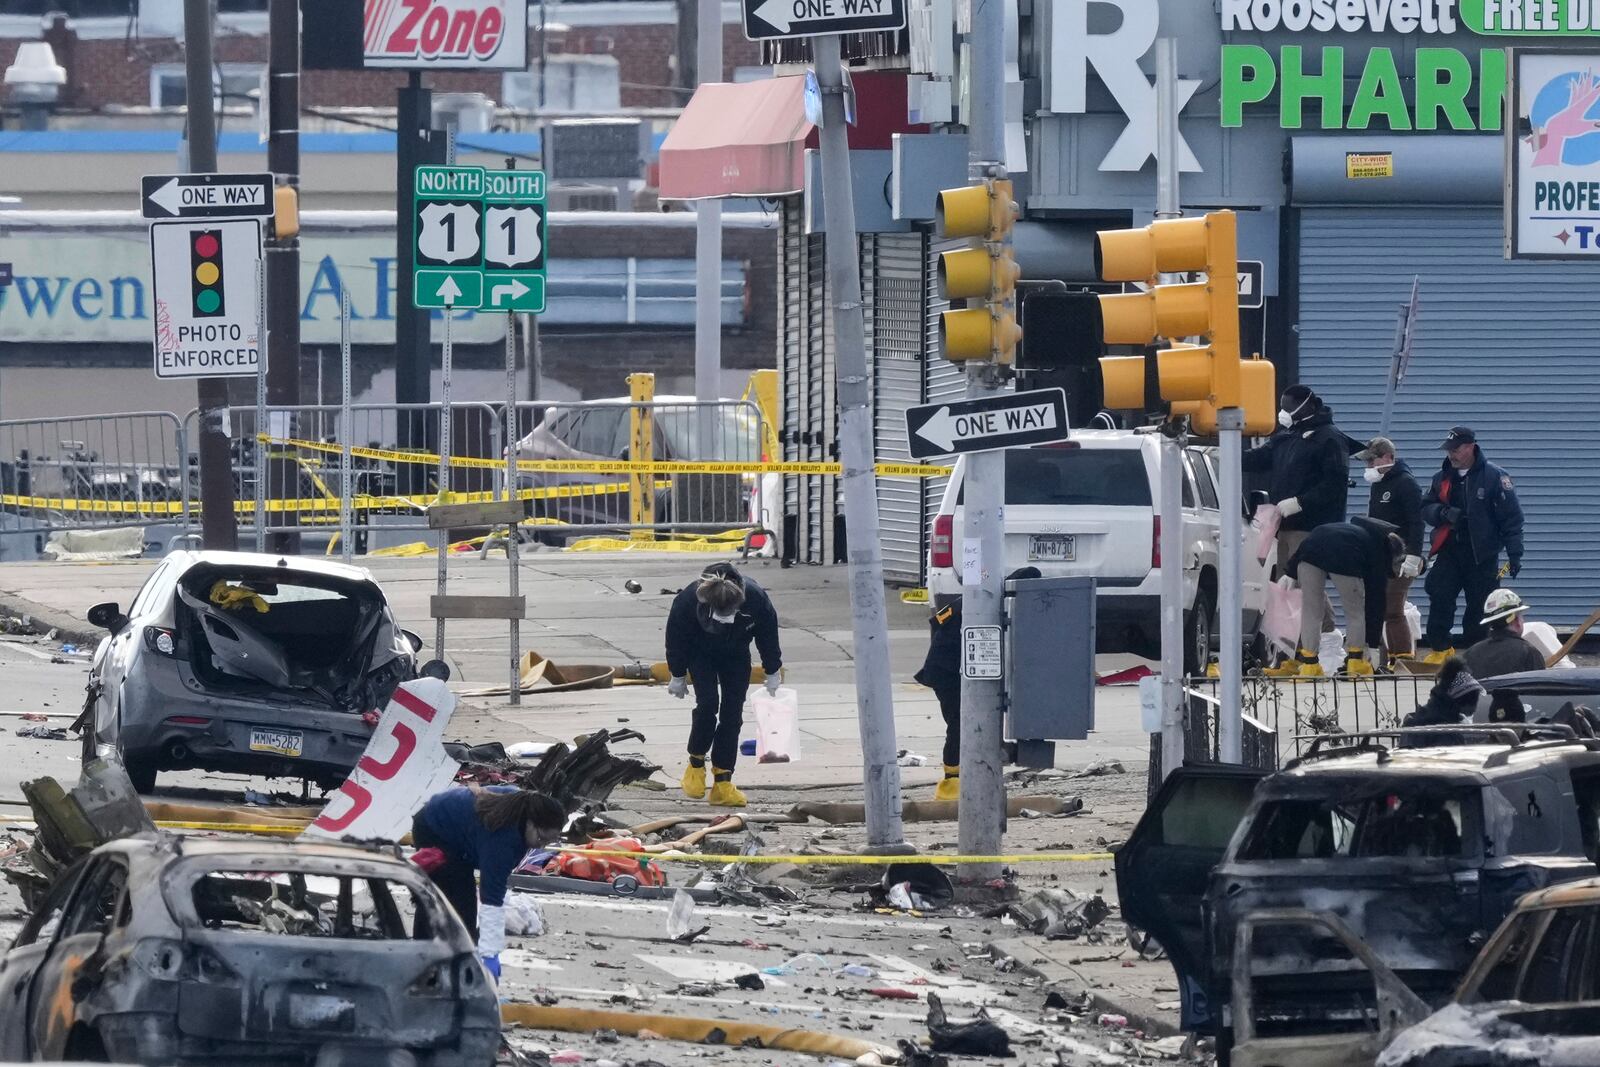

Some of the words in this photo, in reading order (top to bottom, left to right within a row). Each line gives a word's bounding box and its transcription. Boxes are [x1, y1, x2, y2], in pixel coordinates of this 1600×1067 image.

[793, 0, 835, 18] ONE
[843, 0, 882, 14] WAY
[1222, 0, 1456, 34] Roosevelt
[1484, 0, 1559, 30] FREE
[385, 0, 502, 55] Zone
[182, 187, 216, 205] ONE
[223, 186, 259, 203] WAY
[421, 171, 479, 191] NORTH
[486, 176, 540, 194] SOUTH
[439, 212, 455, 252] 1
[500, 216, 516, 256] 1
[0, 275, 149, 319] wen
[178, 324, 241, 342] PHOTO
[162, 348, 259, 368] ENFORCED
[955, 413, 998, 437] ONE
[1004, 406, 1048, 430] WAY
